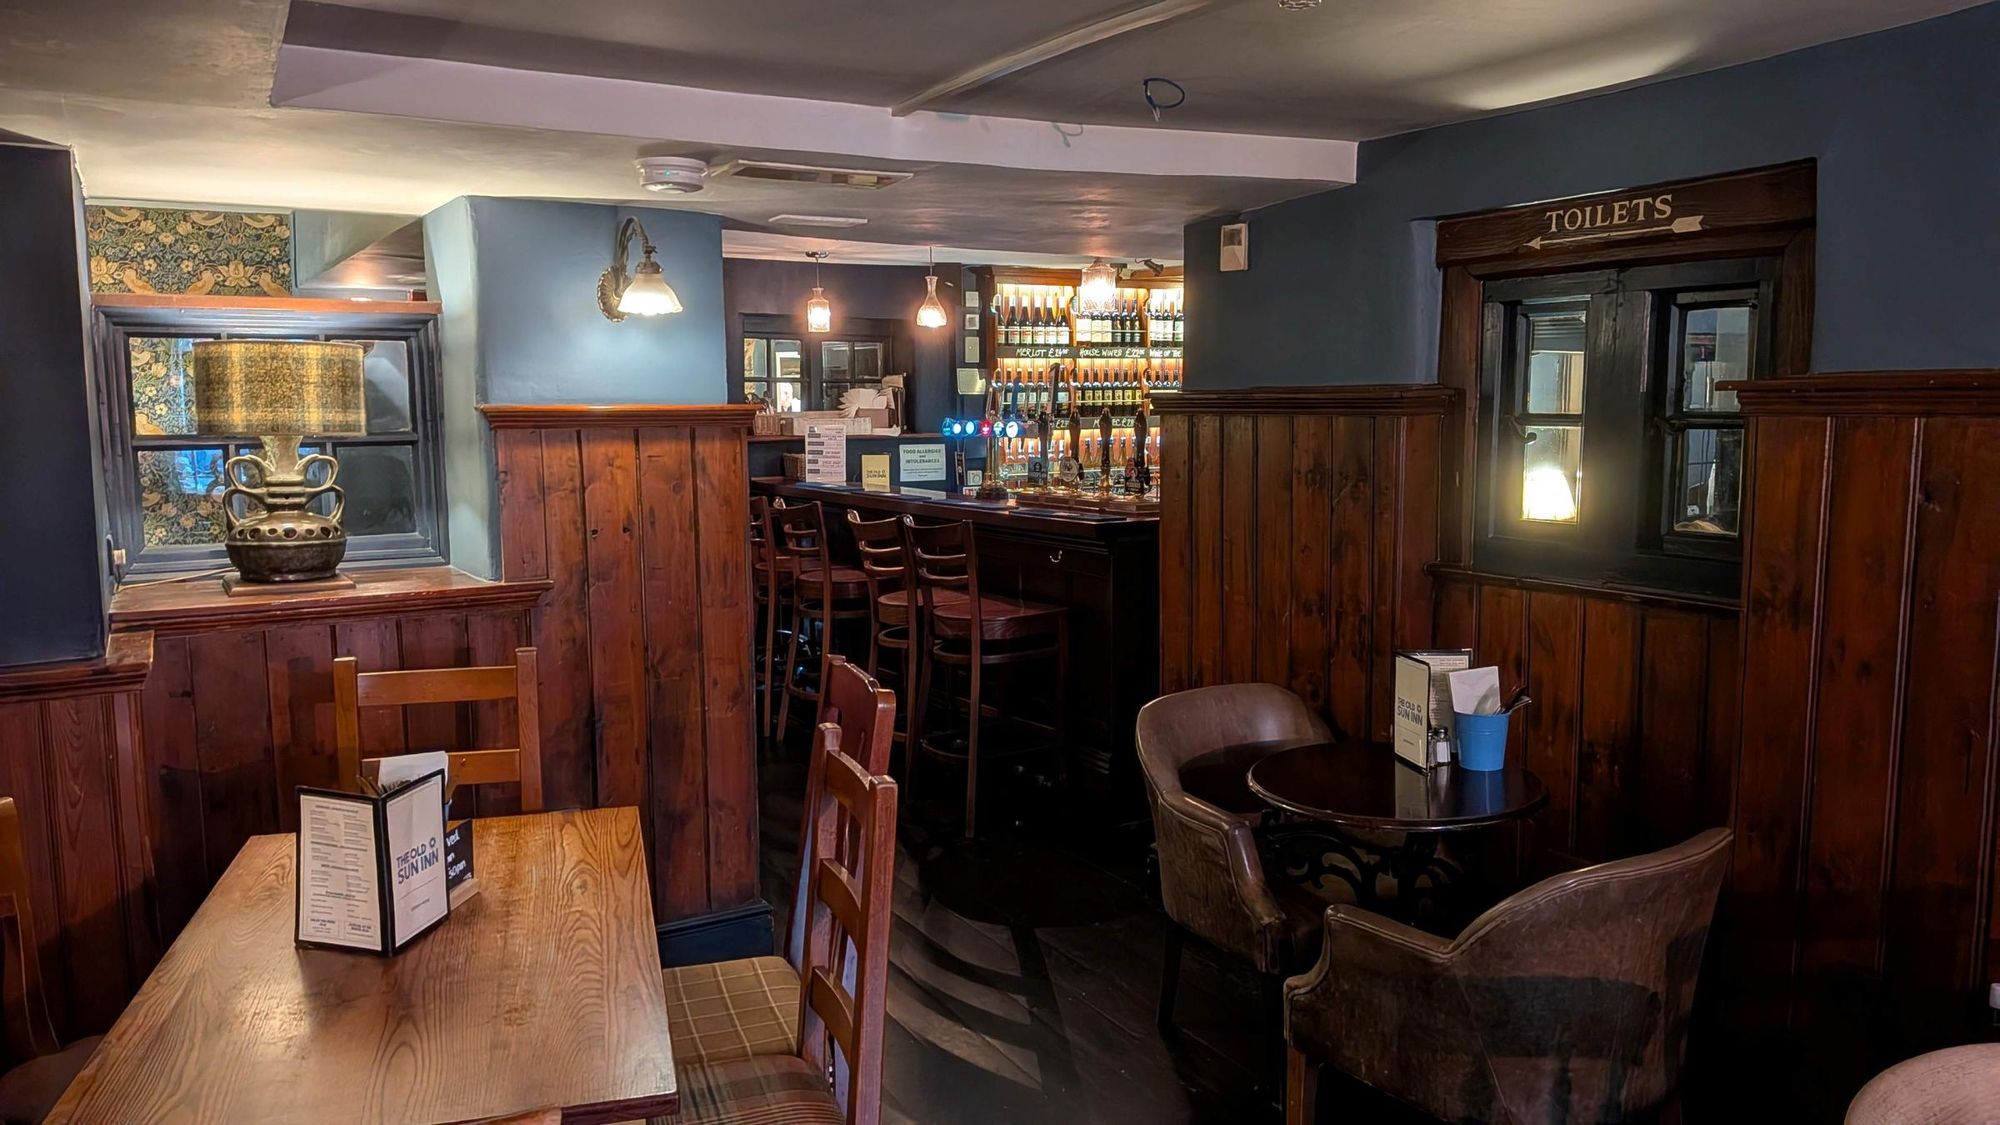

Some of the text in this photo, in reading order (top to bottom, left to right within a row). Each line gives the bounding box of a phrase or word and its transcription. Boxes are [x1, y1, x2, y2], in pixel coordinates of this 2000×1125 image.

[1544, 194, 1673, 233] TOILETS
[1015, 347, 1047, 358] MERLOT
[1079, 347, 1101, 358] HOUSE
[1397, 705, 1423, 726] SUN INN
[396, 851, 410, 868] THE
[410, 843, 427, 859] OLD
[397, 860, 419, 885] SUN
[420, 848, 439, 871] INN
